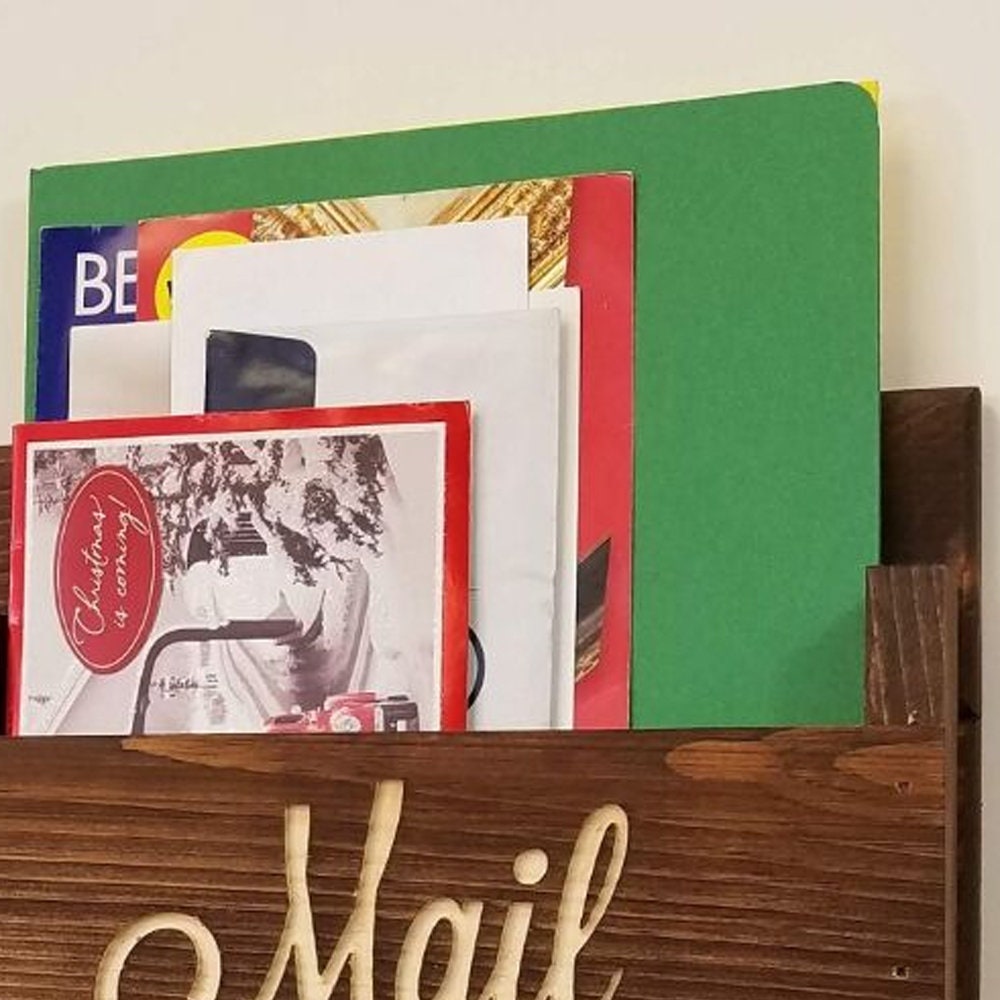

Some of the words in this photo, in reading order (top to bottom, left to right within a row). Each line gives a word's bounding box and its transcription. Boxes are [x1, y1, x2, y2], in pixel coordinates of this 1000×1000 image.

[73, 494, 109, 646] Christmas
[108, 494, 150, 597] coming!
[113, 606, 129, 628] is
